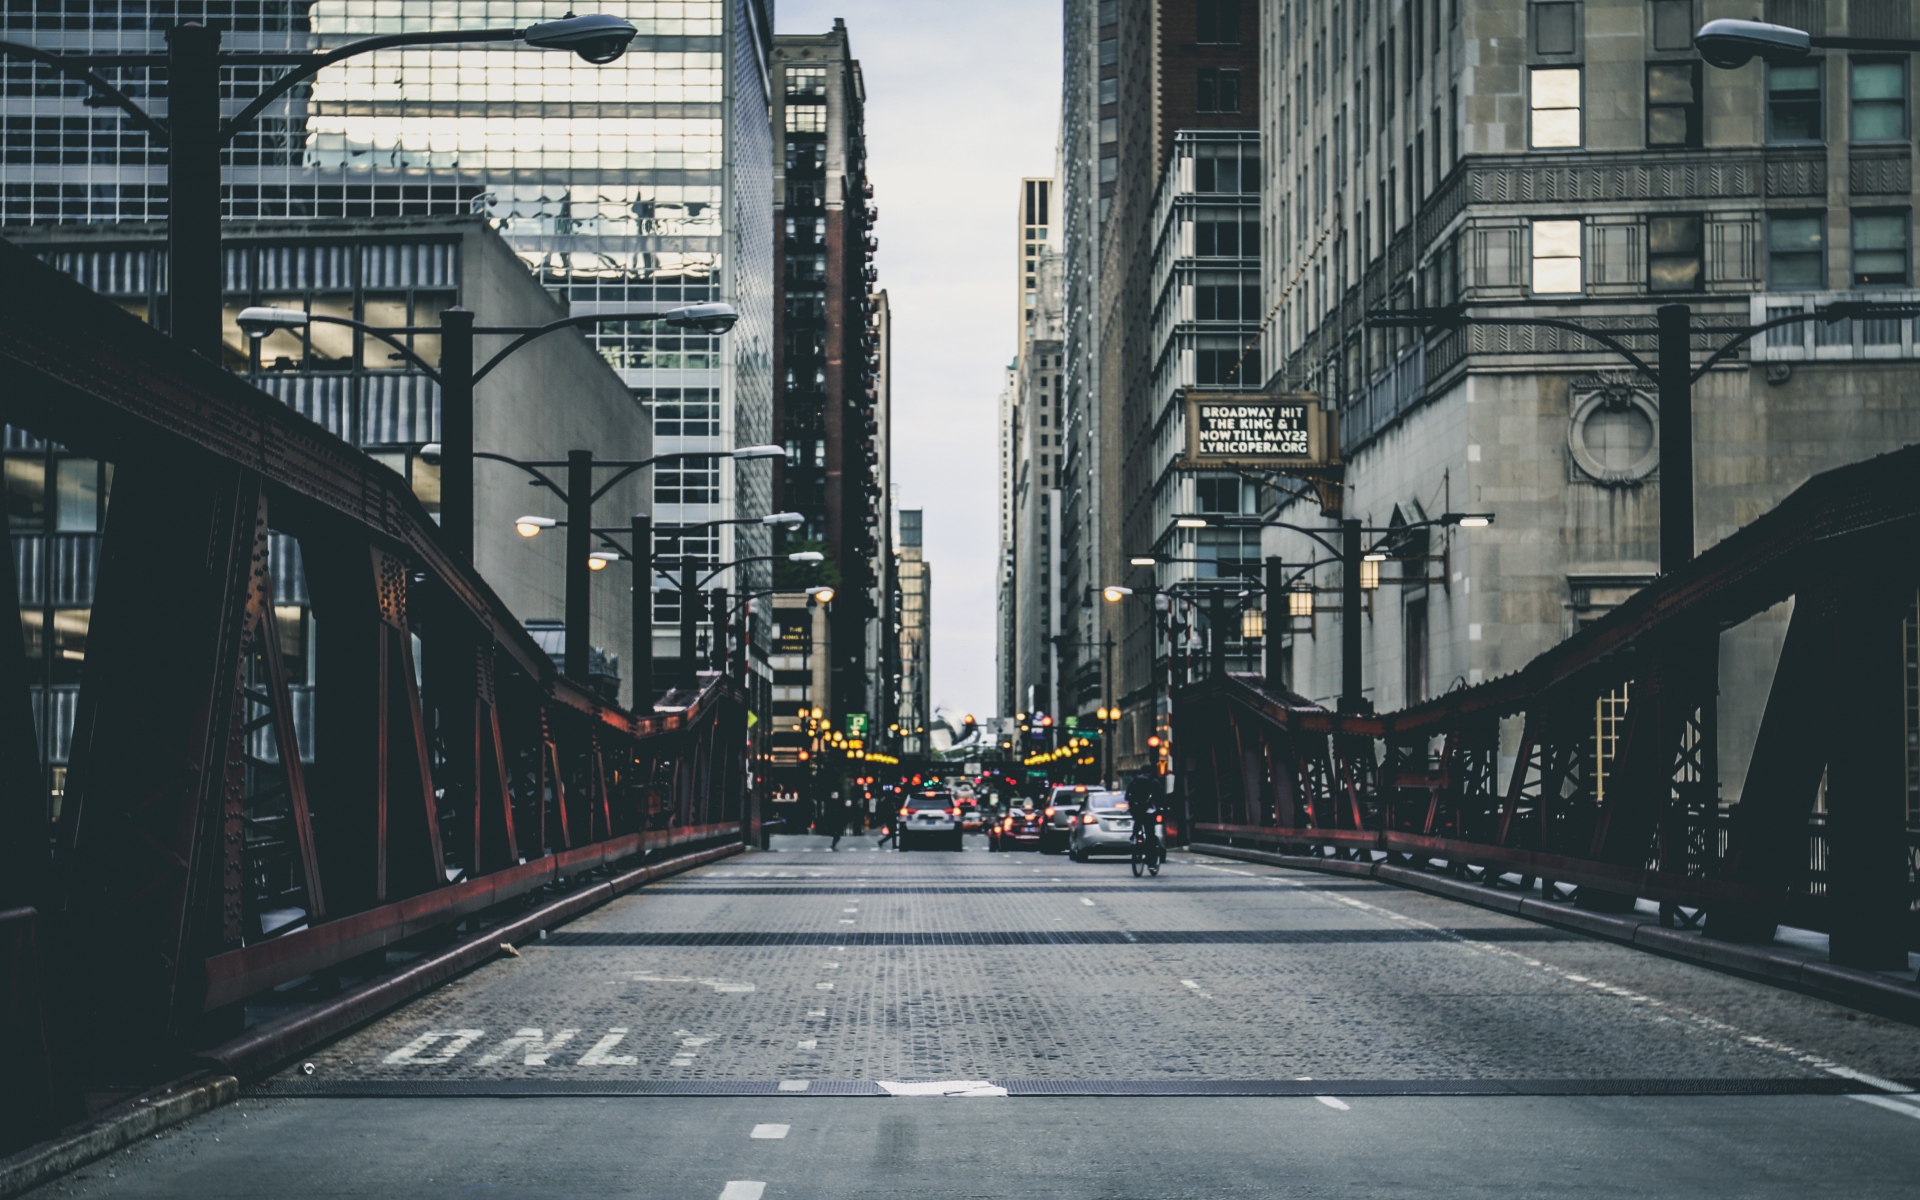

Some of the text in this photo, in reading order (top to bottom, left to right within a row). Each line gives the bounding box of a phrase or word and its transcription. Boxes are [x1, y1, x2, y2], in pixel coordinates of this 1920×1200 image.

[1202, 407, 1303, 418] BROADWAY HIT
[1208, 418, 1235, 430] THE
[1240, 418, 1273, 430] KING
[1277, 418, 1288, 430] &
[1200, 430, 1231, 441] NOW
[1232, 430, 1261, 441] TILL
[1200, 442, 1307, 453] LYRICOPERA.ORG
[383, 1027, 721, 1067] ONLY
